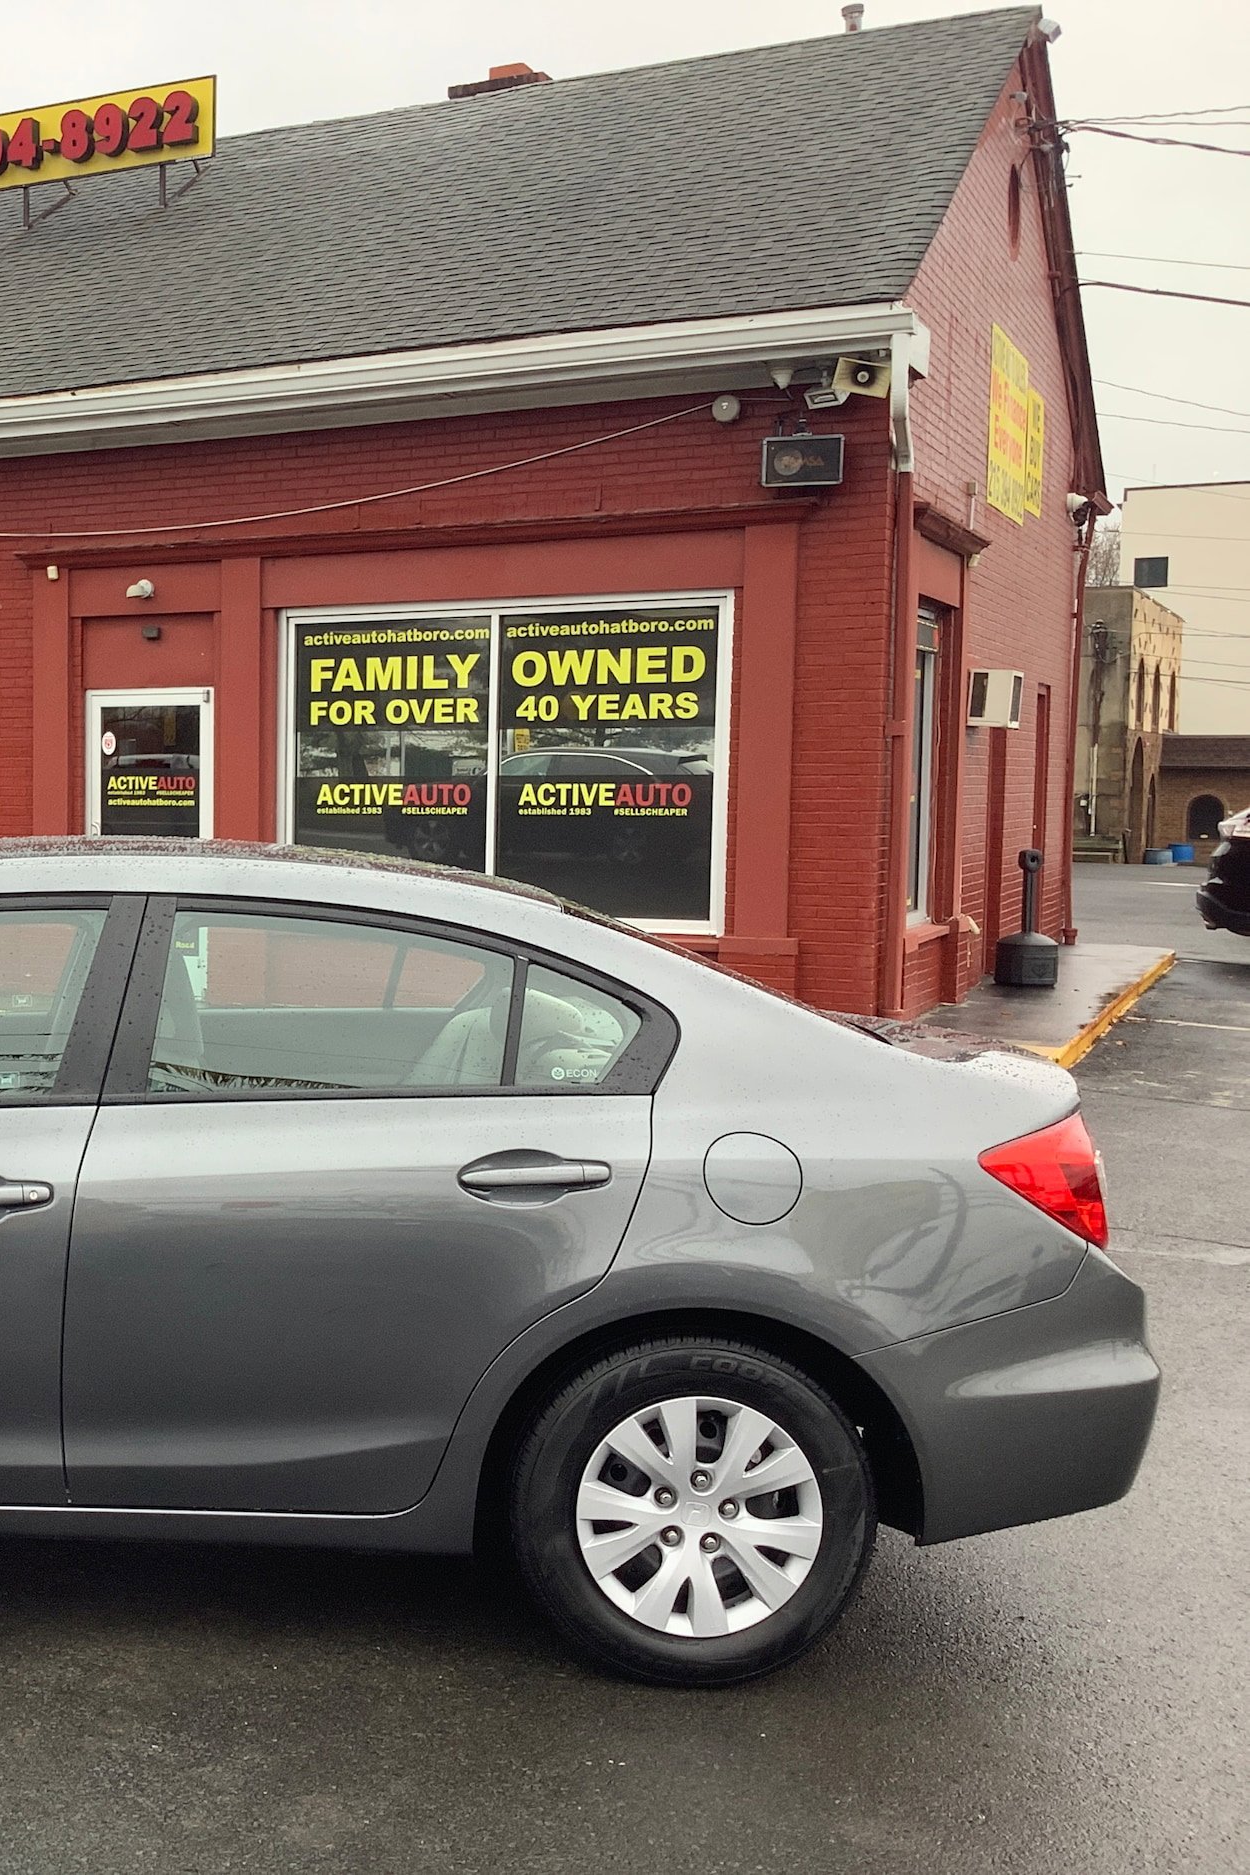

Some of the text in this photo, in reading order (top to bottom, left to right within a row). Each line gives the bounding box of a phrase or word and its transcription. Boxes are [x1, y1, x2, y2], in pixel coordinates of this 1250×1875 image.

[304, 627, 490, 646] activeautohatboro.com
[506, 618, 714, 638] activeautohatboro.com
[310, 653, 481, 693] FAMILY
[511, 645, 706, 687] OWNED
[310, 697, 479, 726] FOR OVER
[515, 691, 699, 722] 40 YEARS
[316, 806, 468, 815] established 1983 #SELLSCHEAPER
[518, 808, 688, 817] established 1983 #SELLSCHEAPER
[566, 1068, 597, 1078] ECON
